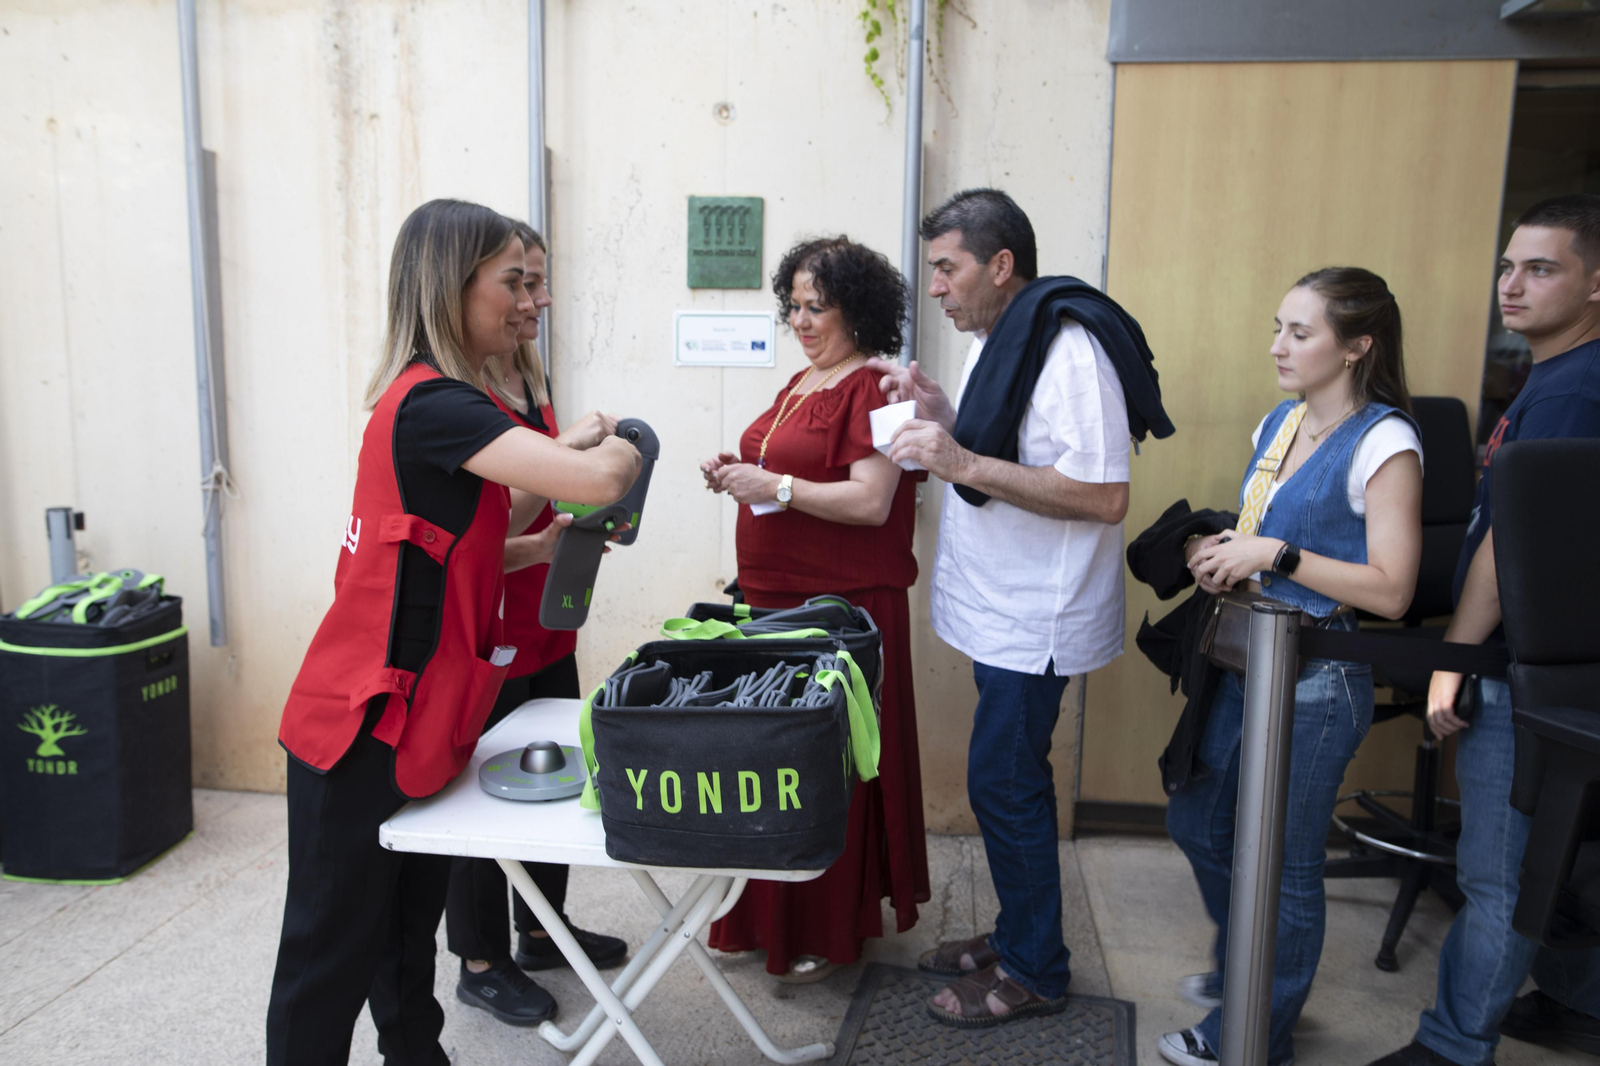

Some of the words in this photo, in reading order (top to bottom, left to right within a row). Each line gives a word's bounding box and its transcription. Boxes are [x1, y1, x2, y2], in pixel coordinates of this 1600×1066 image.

[562, 594, 574, 608] XL
[141, 675, 178, 702] YONDR
[26, 758, 78, 775] YONDR
[625, 768, 802, 814] YONDR
